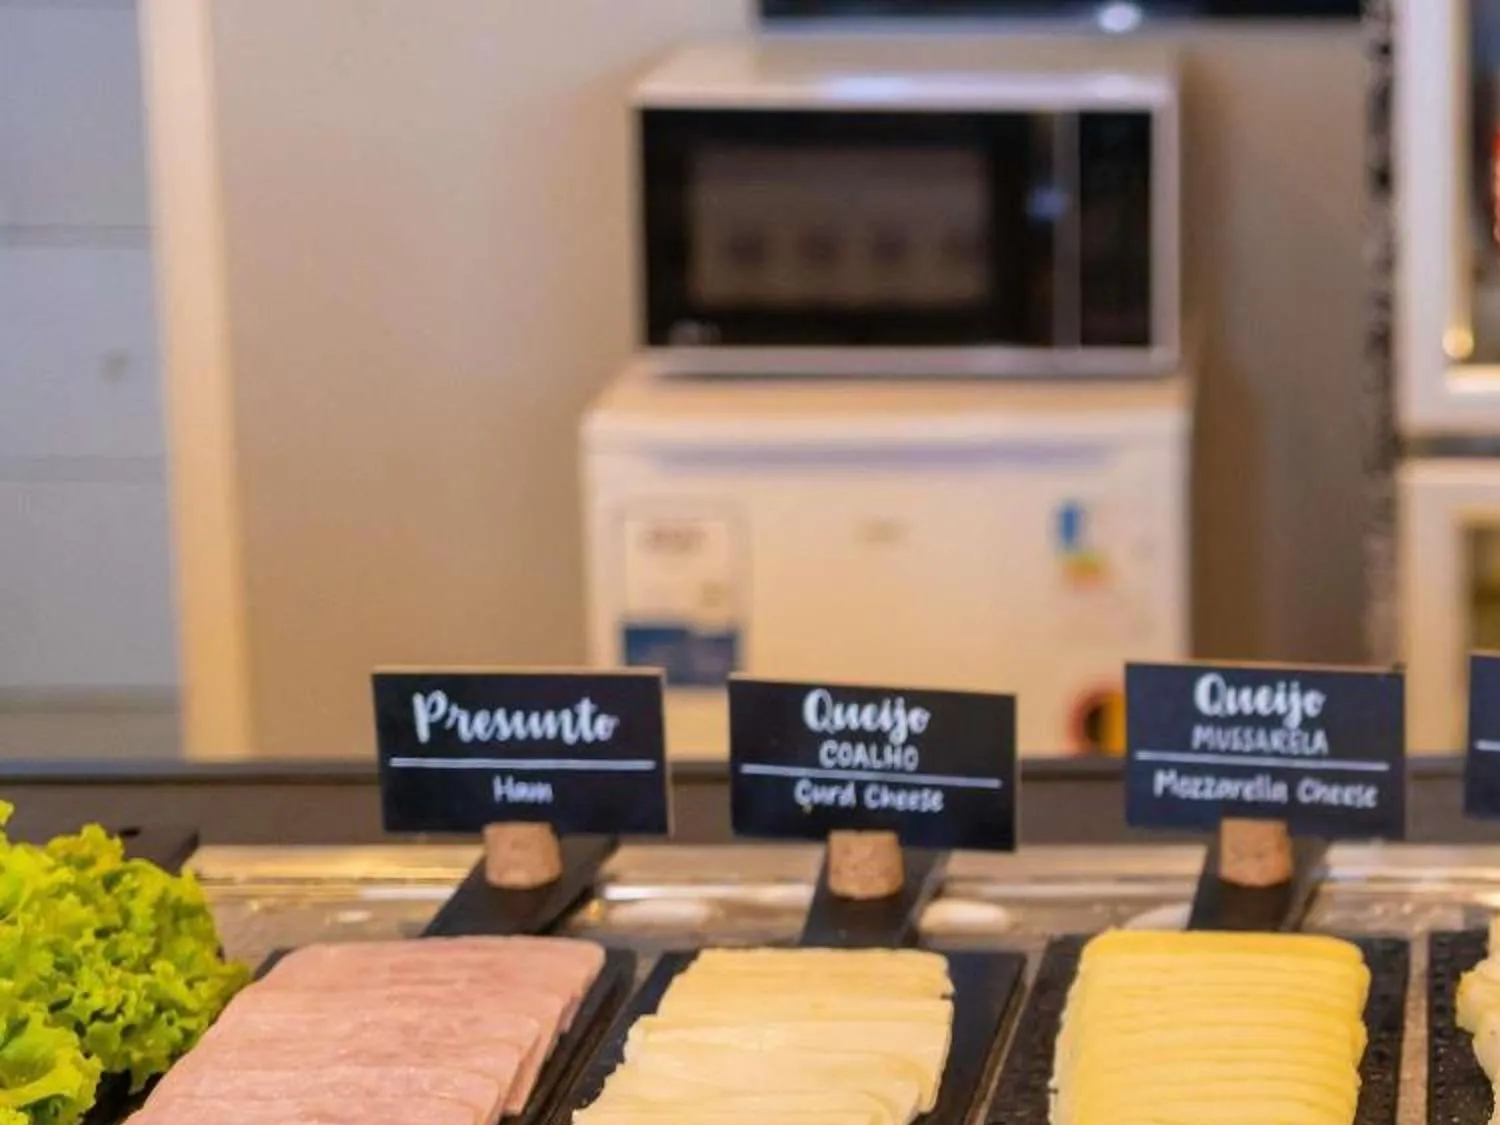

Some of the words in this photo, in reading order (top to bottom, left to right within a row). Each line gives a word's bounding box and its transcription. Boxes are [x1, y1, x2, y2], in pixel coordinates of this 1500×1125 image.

[1194, 672, 1327, 729] Queijo
[412, 689, 620, 745] Presunto
[803, 688, 931, 746] Queijo
[819, 739, 919, 773] COALHO
[1191, 725, 1329, 755] MUSSARELA
[493, 775, 553, 804] Ham
[864, 782, 944, 813] Cheese
[1297, 777, 1378, 808] Cheese
